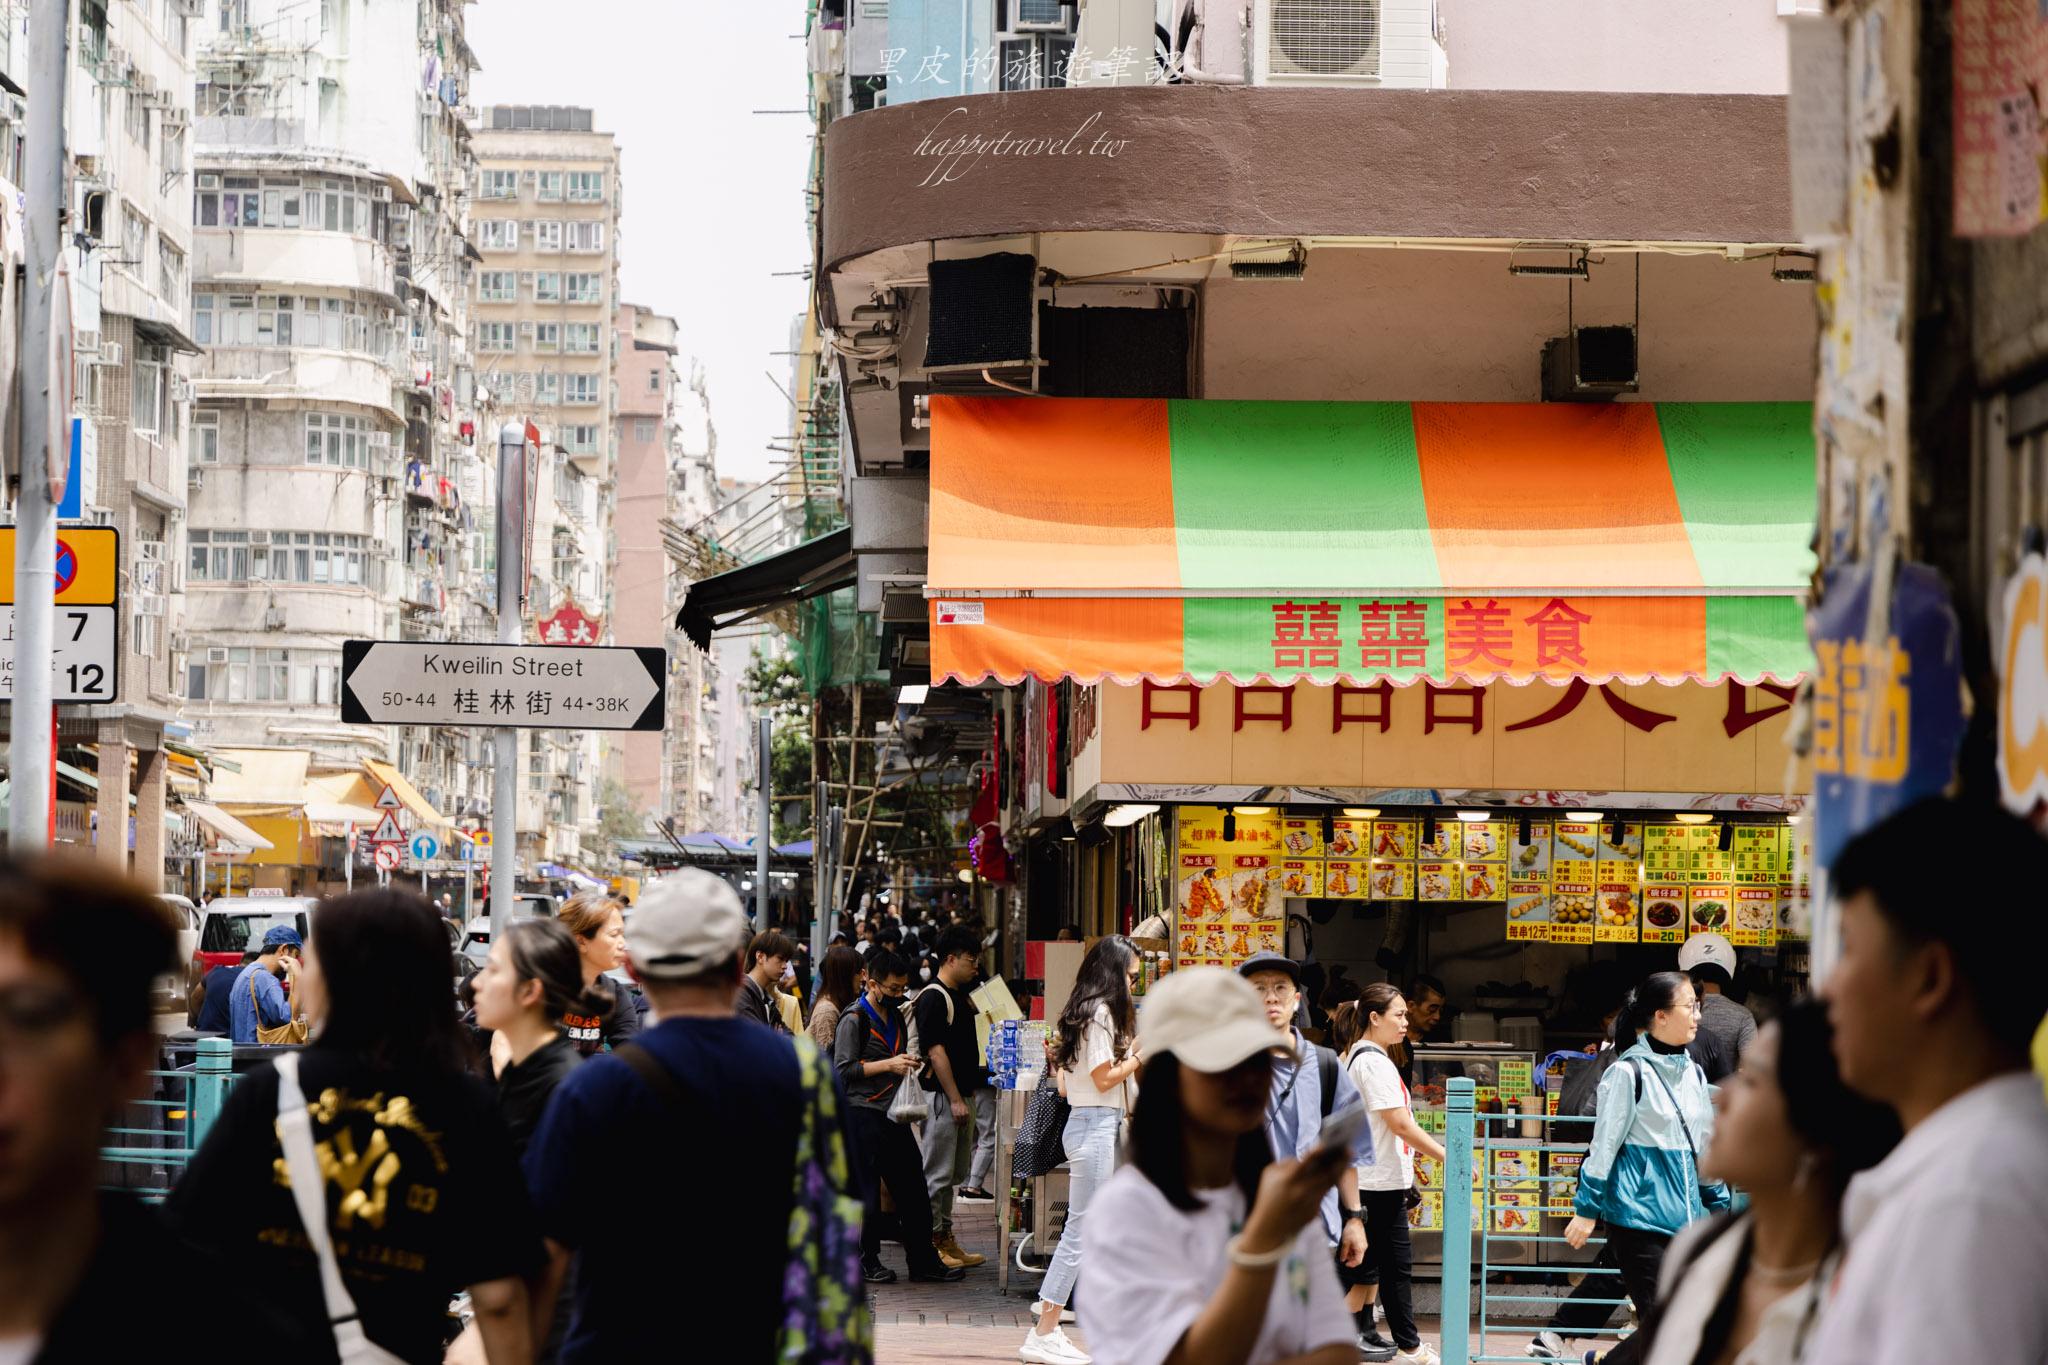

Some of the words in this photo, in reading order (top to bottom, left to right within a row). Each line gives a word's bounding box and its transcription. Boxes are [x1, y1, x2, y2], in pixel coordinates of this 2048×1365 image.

[424, 654, 503, 675] Kweilin
[512, 656, 583, 677] Street
[66, 663, 104, 693] 12
[453, 687, 552, 716] 桂林街
[1191, 828, 1272, 842] 招牌鎮滷味
[251, 888, 282, 897] TAXI
[1508, 924, 1549, 940] 每串12元
